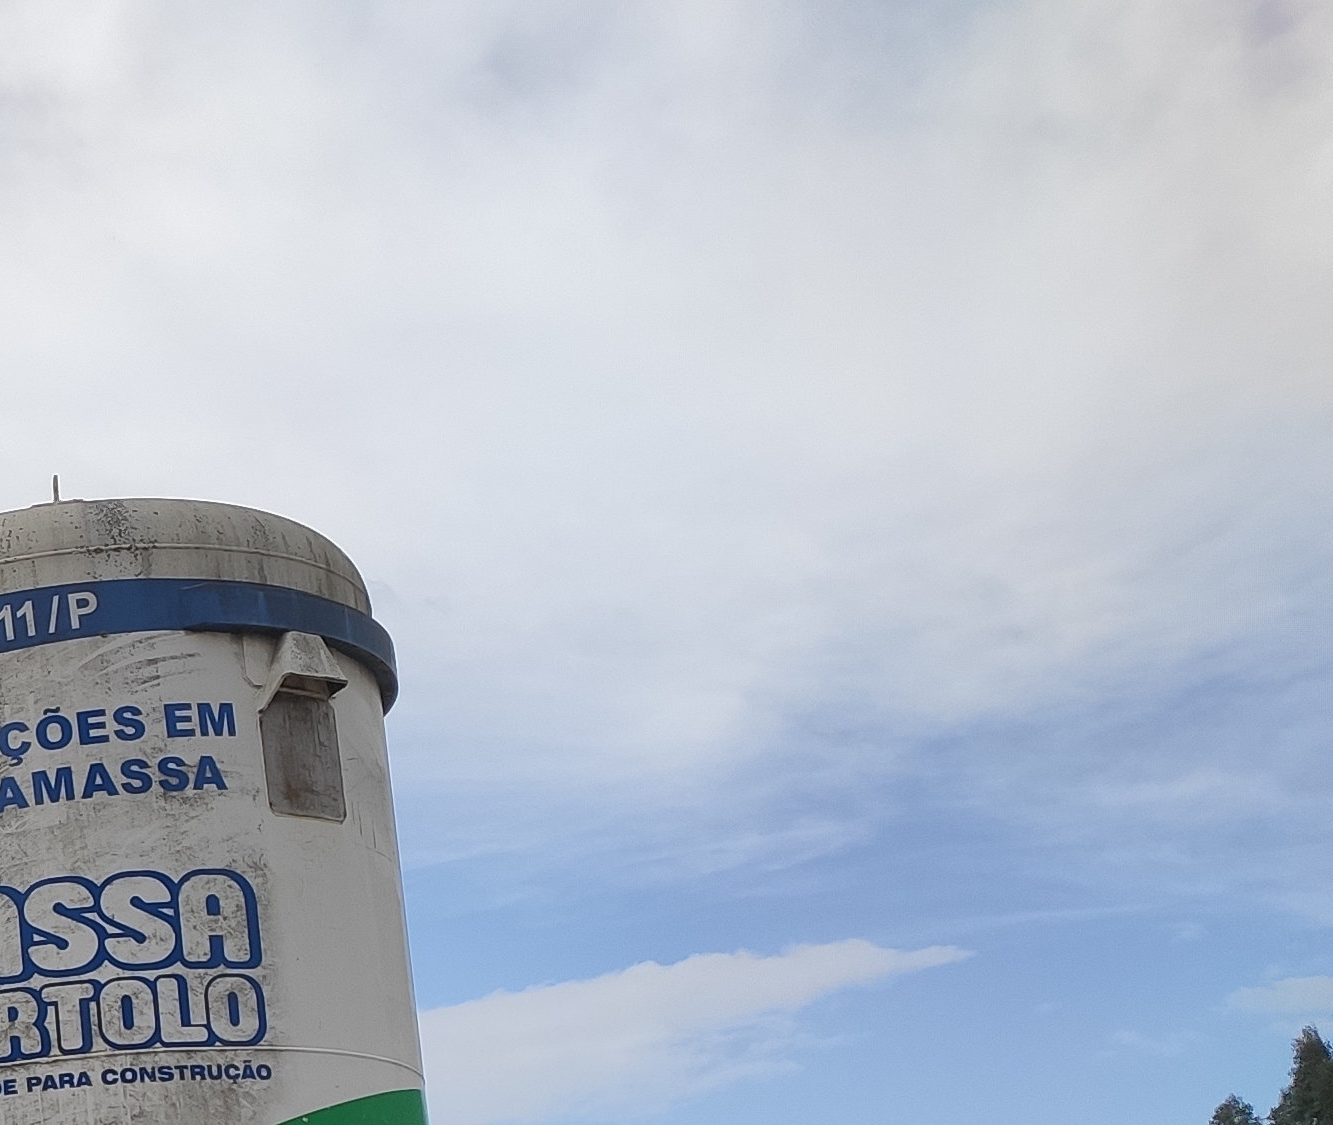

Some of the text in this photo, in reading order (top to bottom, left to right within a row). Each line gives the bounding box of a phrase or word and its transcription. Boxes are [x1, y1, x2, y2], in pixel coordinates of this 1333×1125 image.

[164, 702, 237, 738] EM
[26, 1070, 92, 1092] PARA
[101, 1060, 272, 1084] CONSTRUÇÃO
